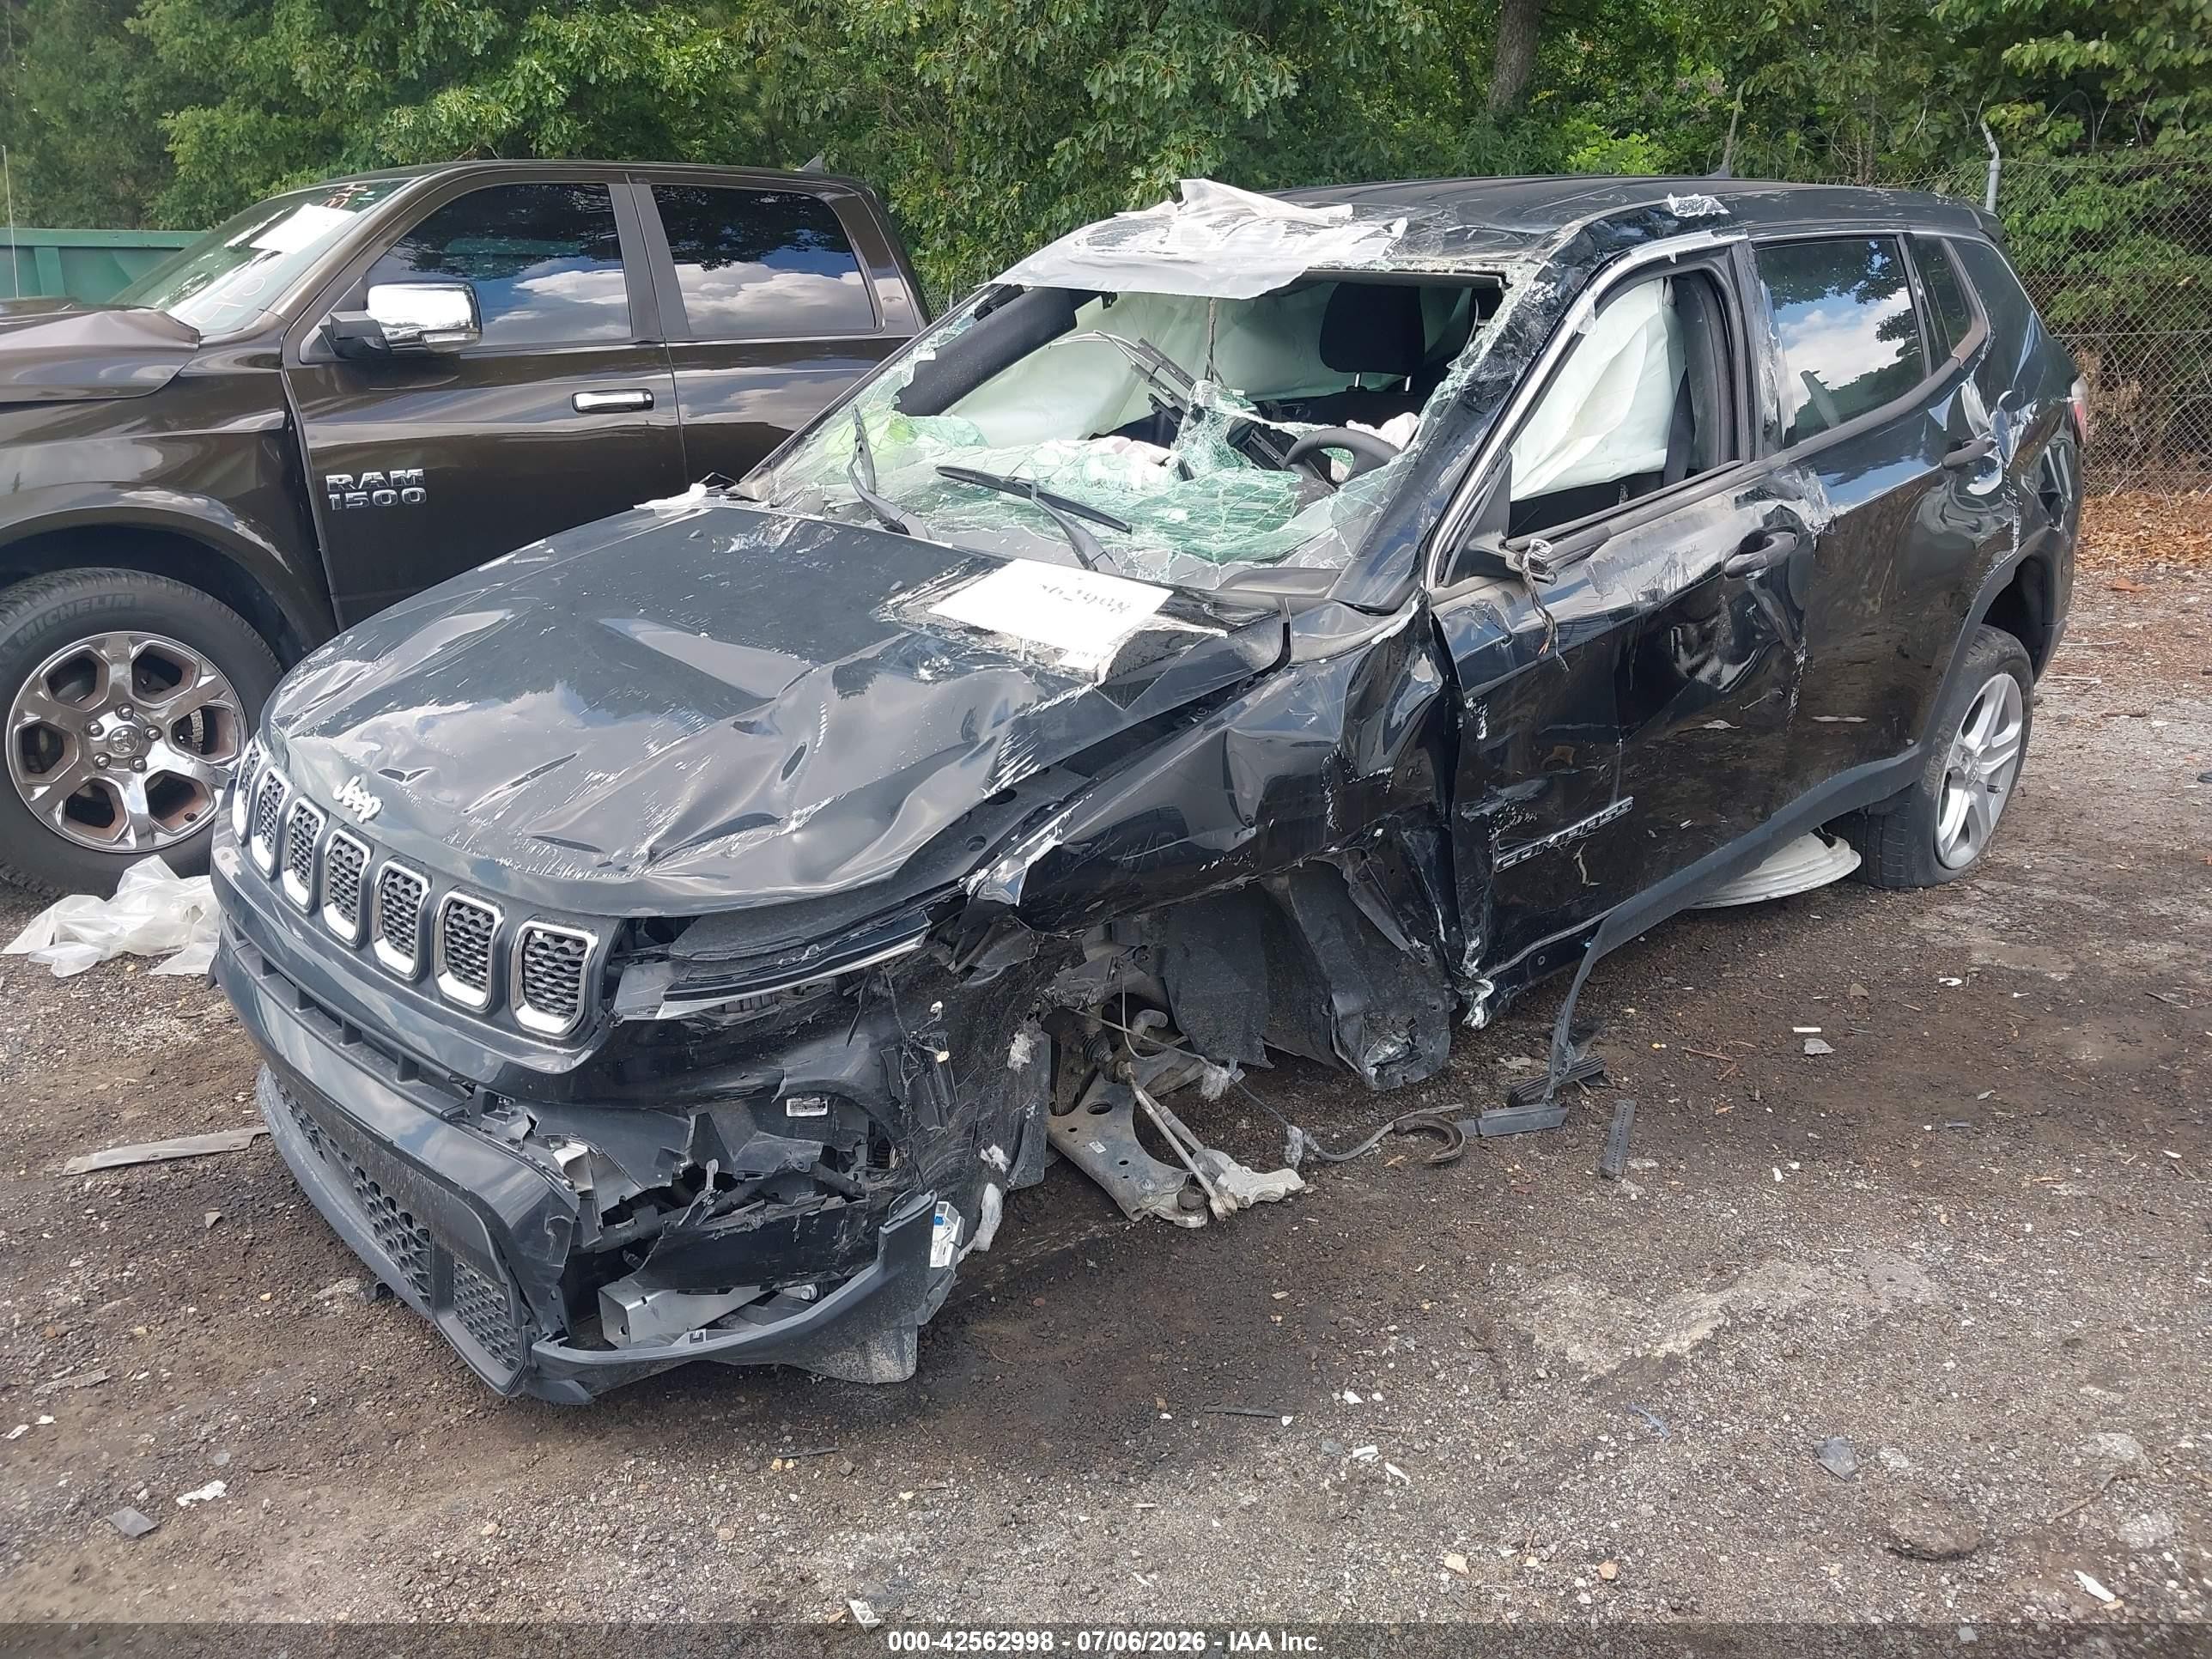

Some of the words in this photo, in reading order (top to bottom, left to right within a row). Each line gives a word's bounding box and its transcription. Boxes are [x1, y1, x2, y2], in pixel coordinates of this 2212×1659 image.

[325, 469, 426, 492] RAM
[329, 487, 427, 511] 1500
[15, 593, 136, 647] MICHELIN
[333, 775, 383, 823] Jeep
[1494, 796, 1634, 872] COMPASS
